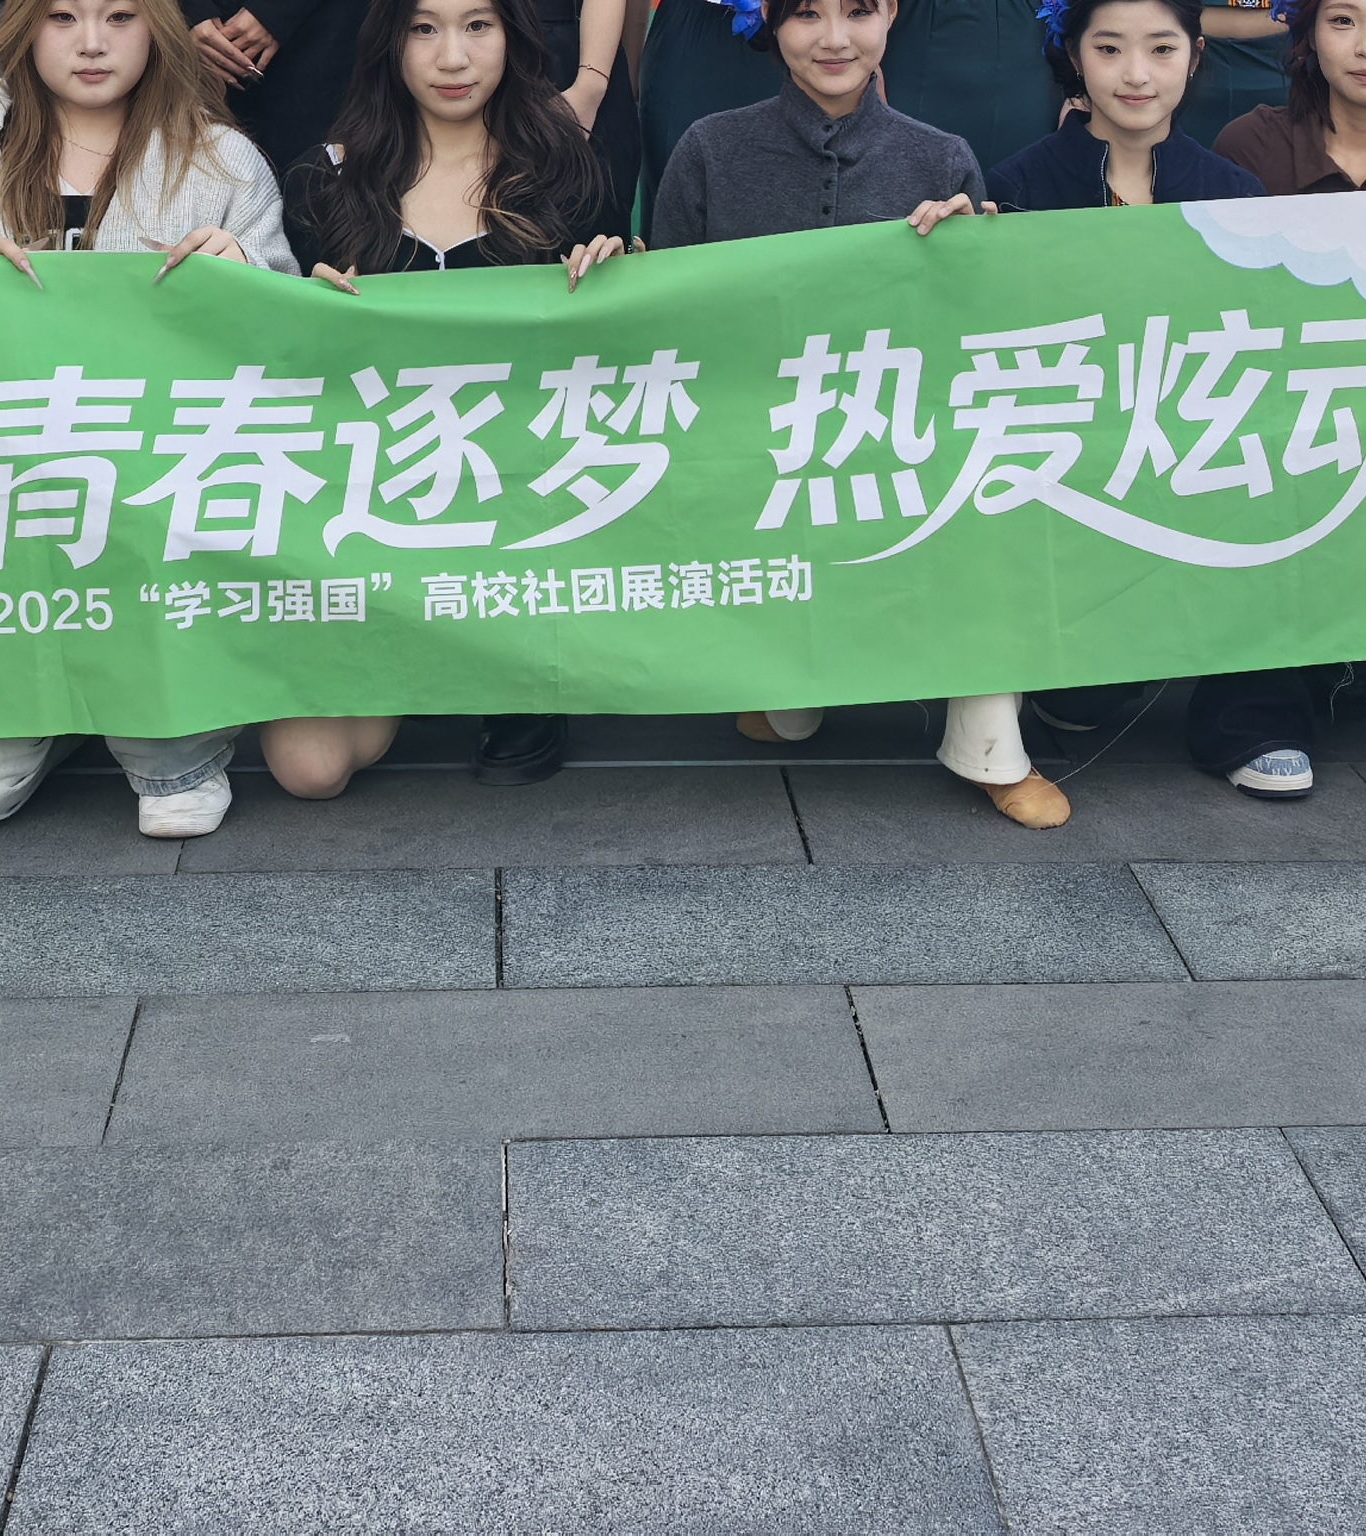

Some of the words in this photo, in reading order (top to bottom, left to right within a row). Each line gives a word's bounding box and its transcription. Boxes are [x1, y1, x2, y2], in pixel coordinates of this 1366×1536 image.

[422, 554, 813, 622] 高校社团展演活动
